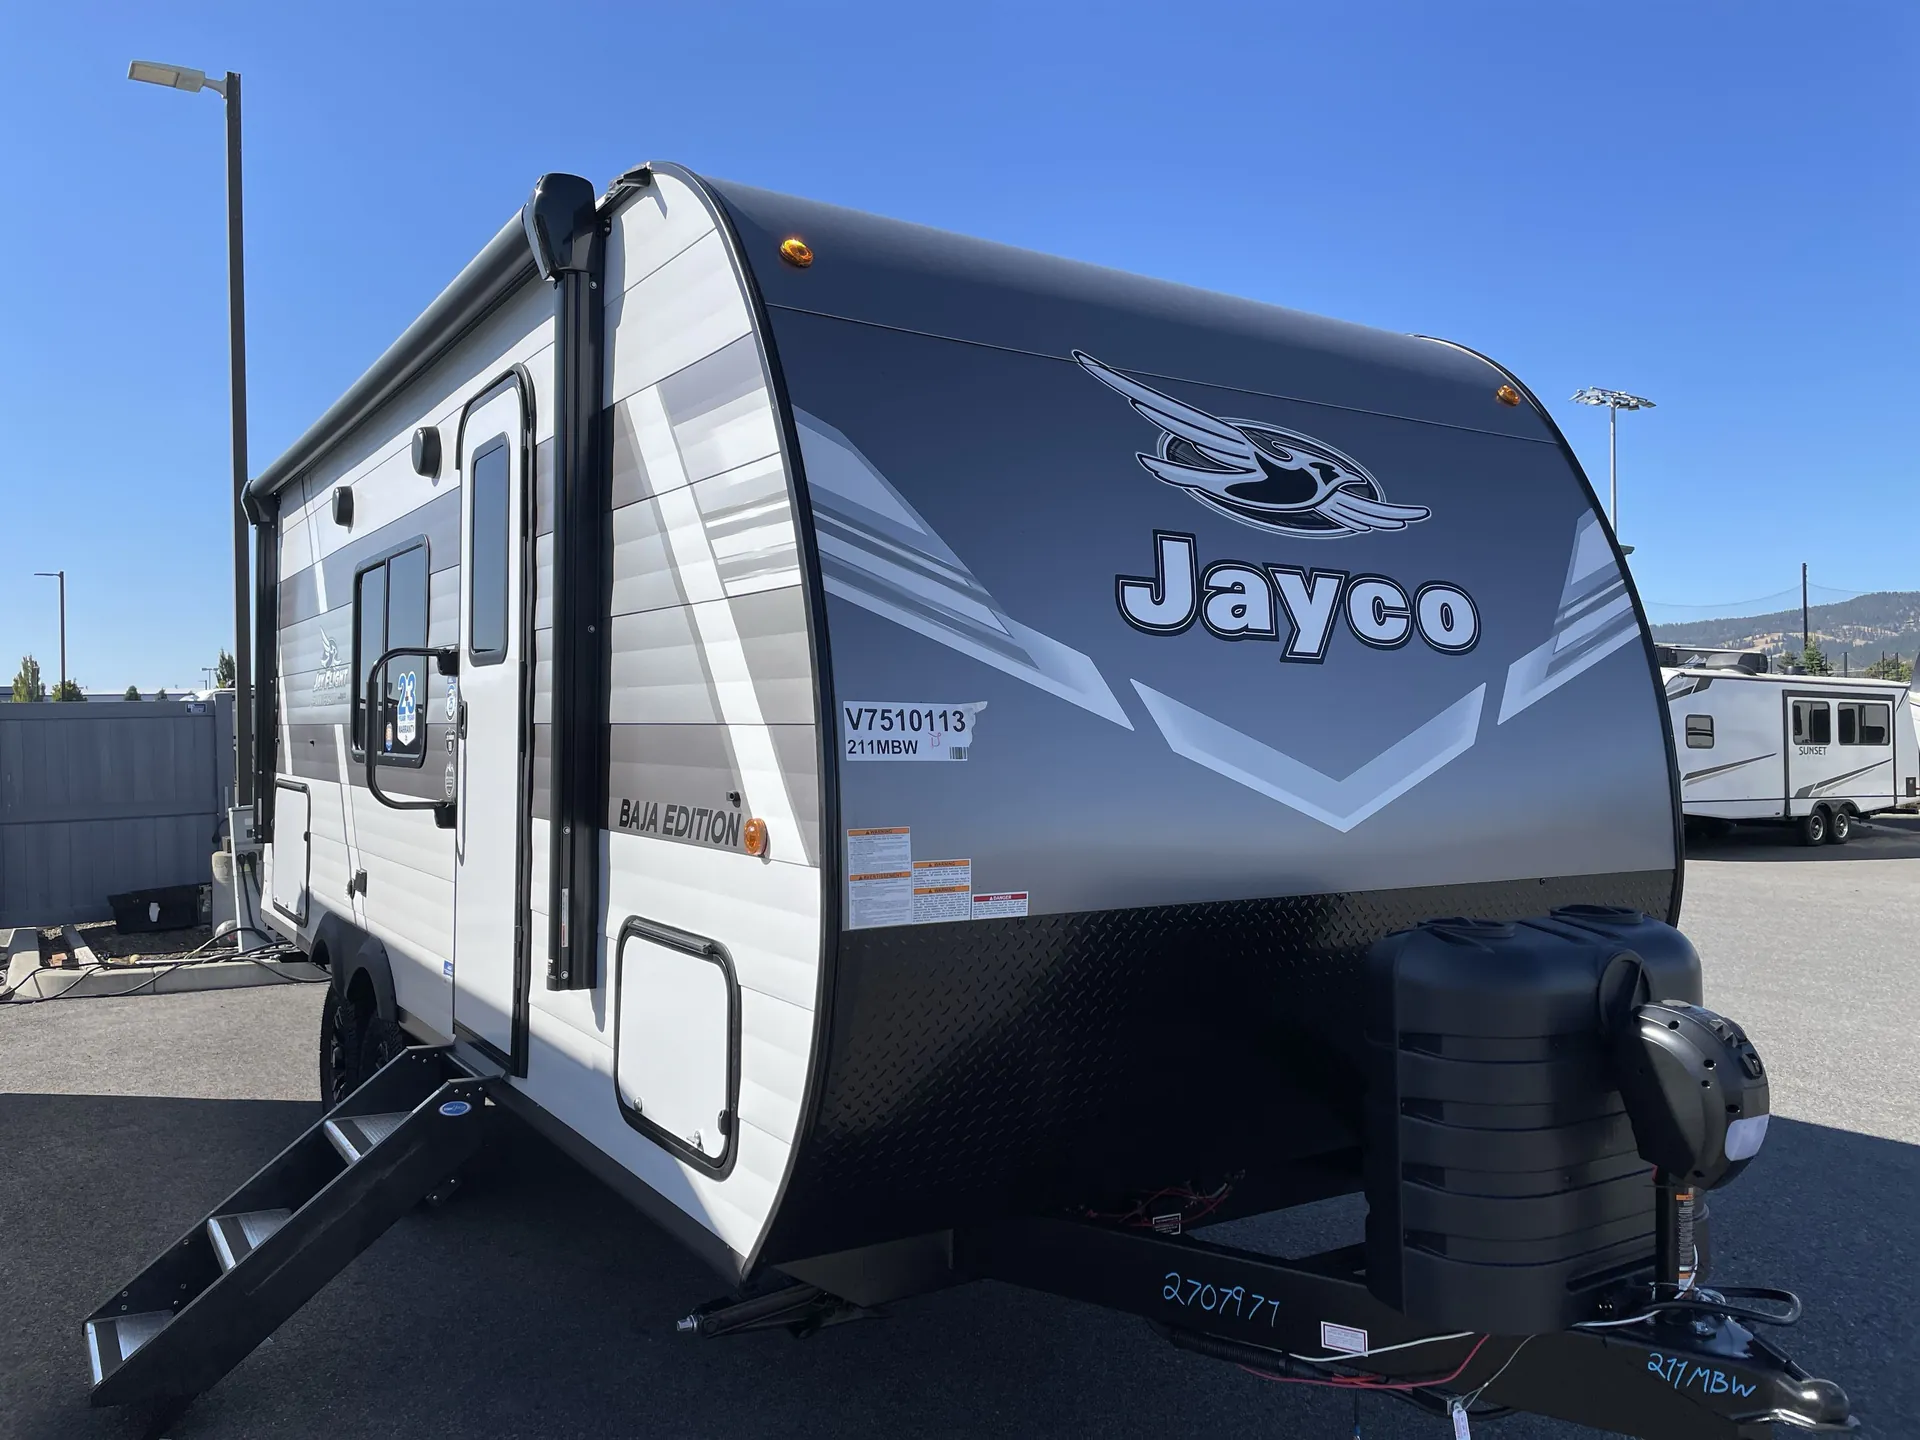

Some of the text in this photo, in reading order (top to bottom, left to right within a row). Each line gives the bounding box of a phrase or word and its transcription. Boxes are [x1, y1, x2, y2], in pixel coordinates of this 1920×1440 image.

[1115, 529, 1481, 664] Jayco
[845, 707, 966, 733] V7510113
[847, 739, 918, 755] 211MBW
[1798, 746, 1827, 756] SUNSET
[618, 798, 742, 847] BAJA EDITION
[1163, 1271, 1280, 1328] 2707977
[1647, 1352, 1757, 1399] 211MBW
